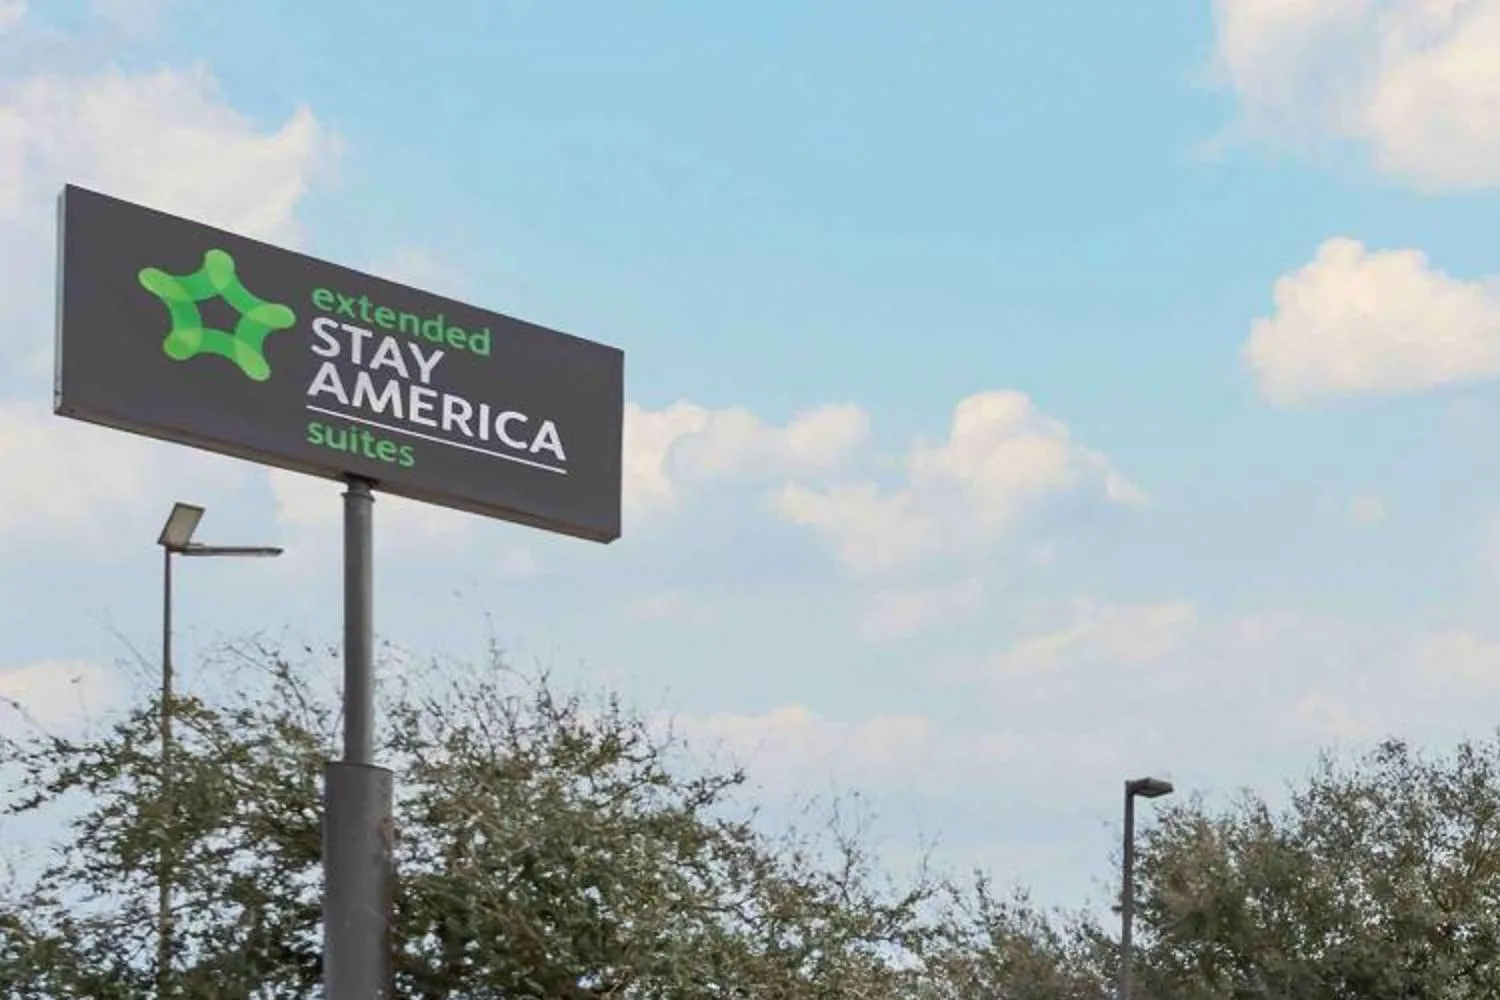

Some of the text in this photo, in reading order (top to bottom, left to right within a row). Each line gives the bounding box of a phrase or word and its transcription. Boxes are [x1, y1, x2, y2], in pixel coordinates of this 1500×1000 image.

[311, 317, 445, 385] STAY
[312, 285, 492, 357] extended
[307, 361, 567, 462] AMERICA
[307, 422, 415, 468] suites
